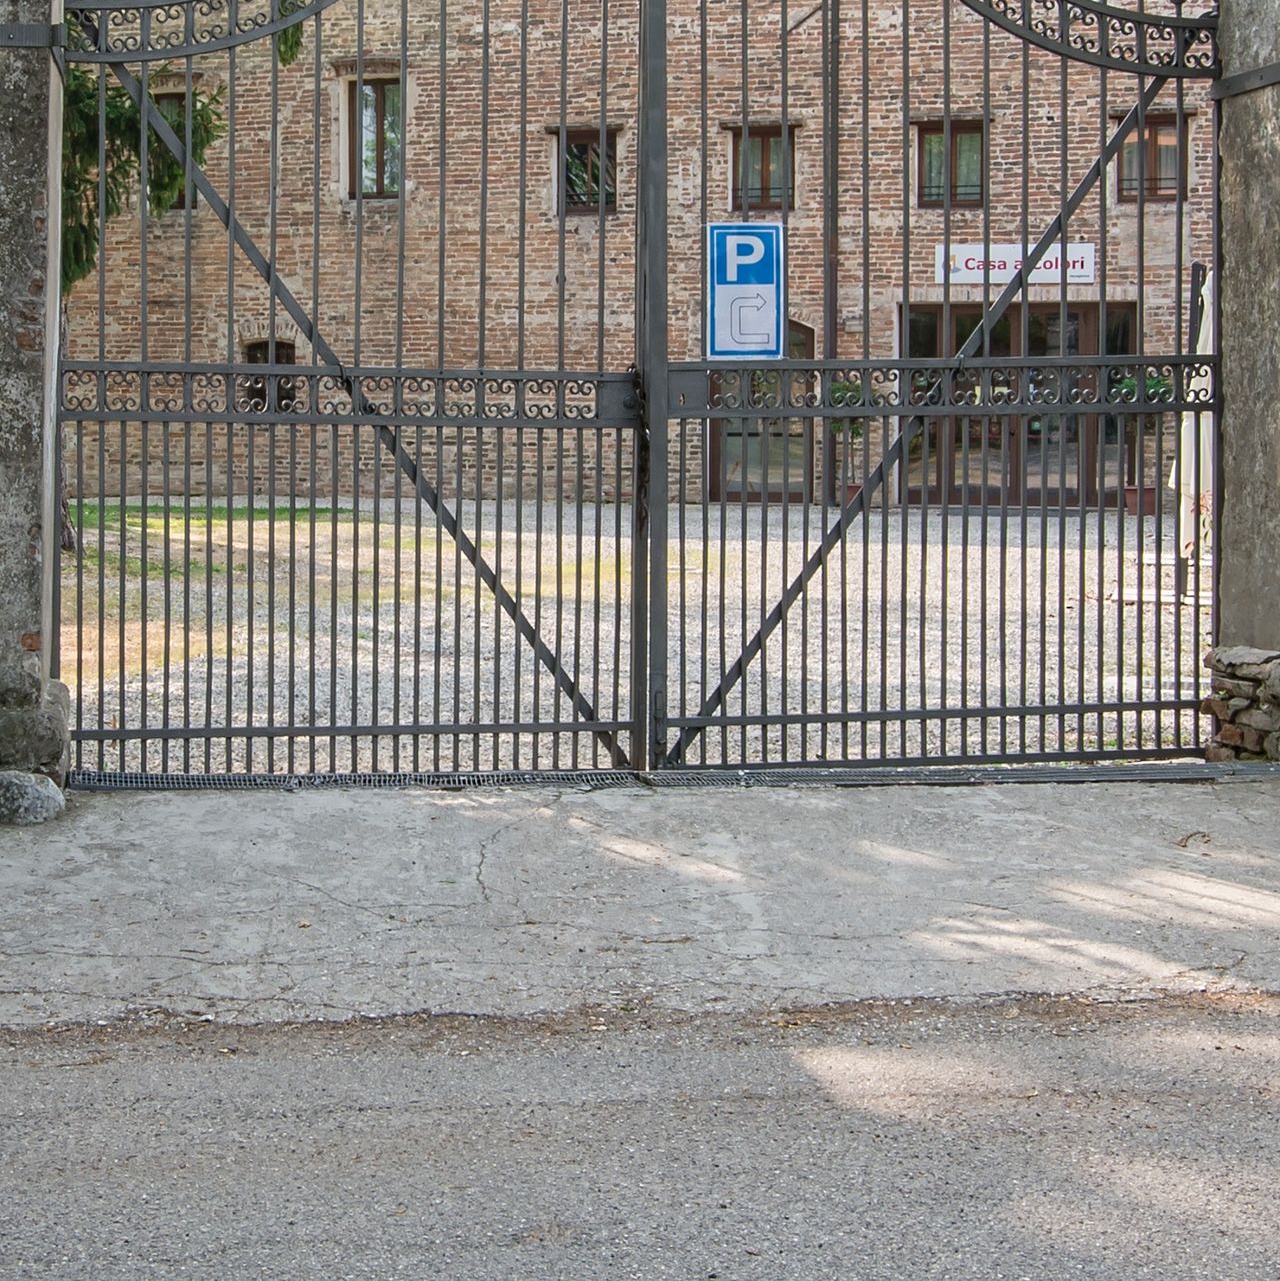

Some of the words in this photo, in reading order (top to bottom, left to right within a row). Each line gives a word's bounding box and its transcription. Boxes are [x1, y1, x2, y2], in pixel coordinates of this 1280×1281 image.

[726, 235, 765, 282] P
[964, 257, 1007, 270] Casa
[1031, 256, 1085, 270] olri
